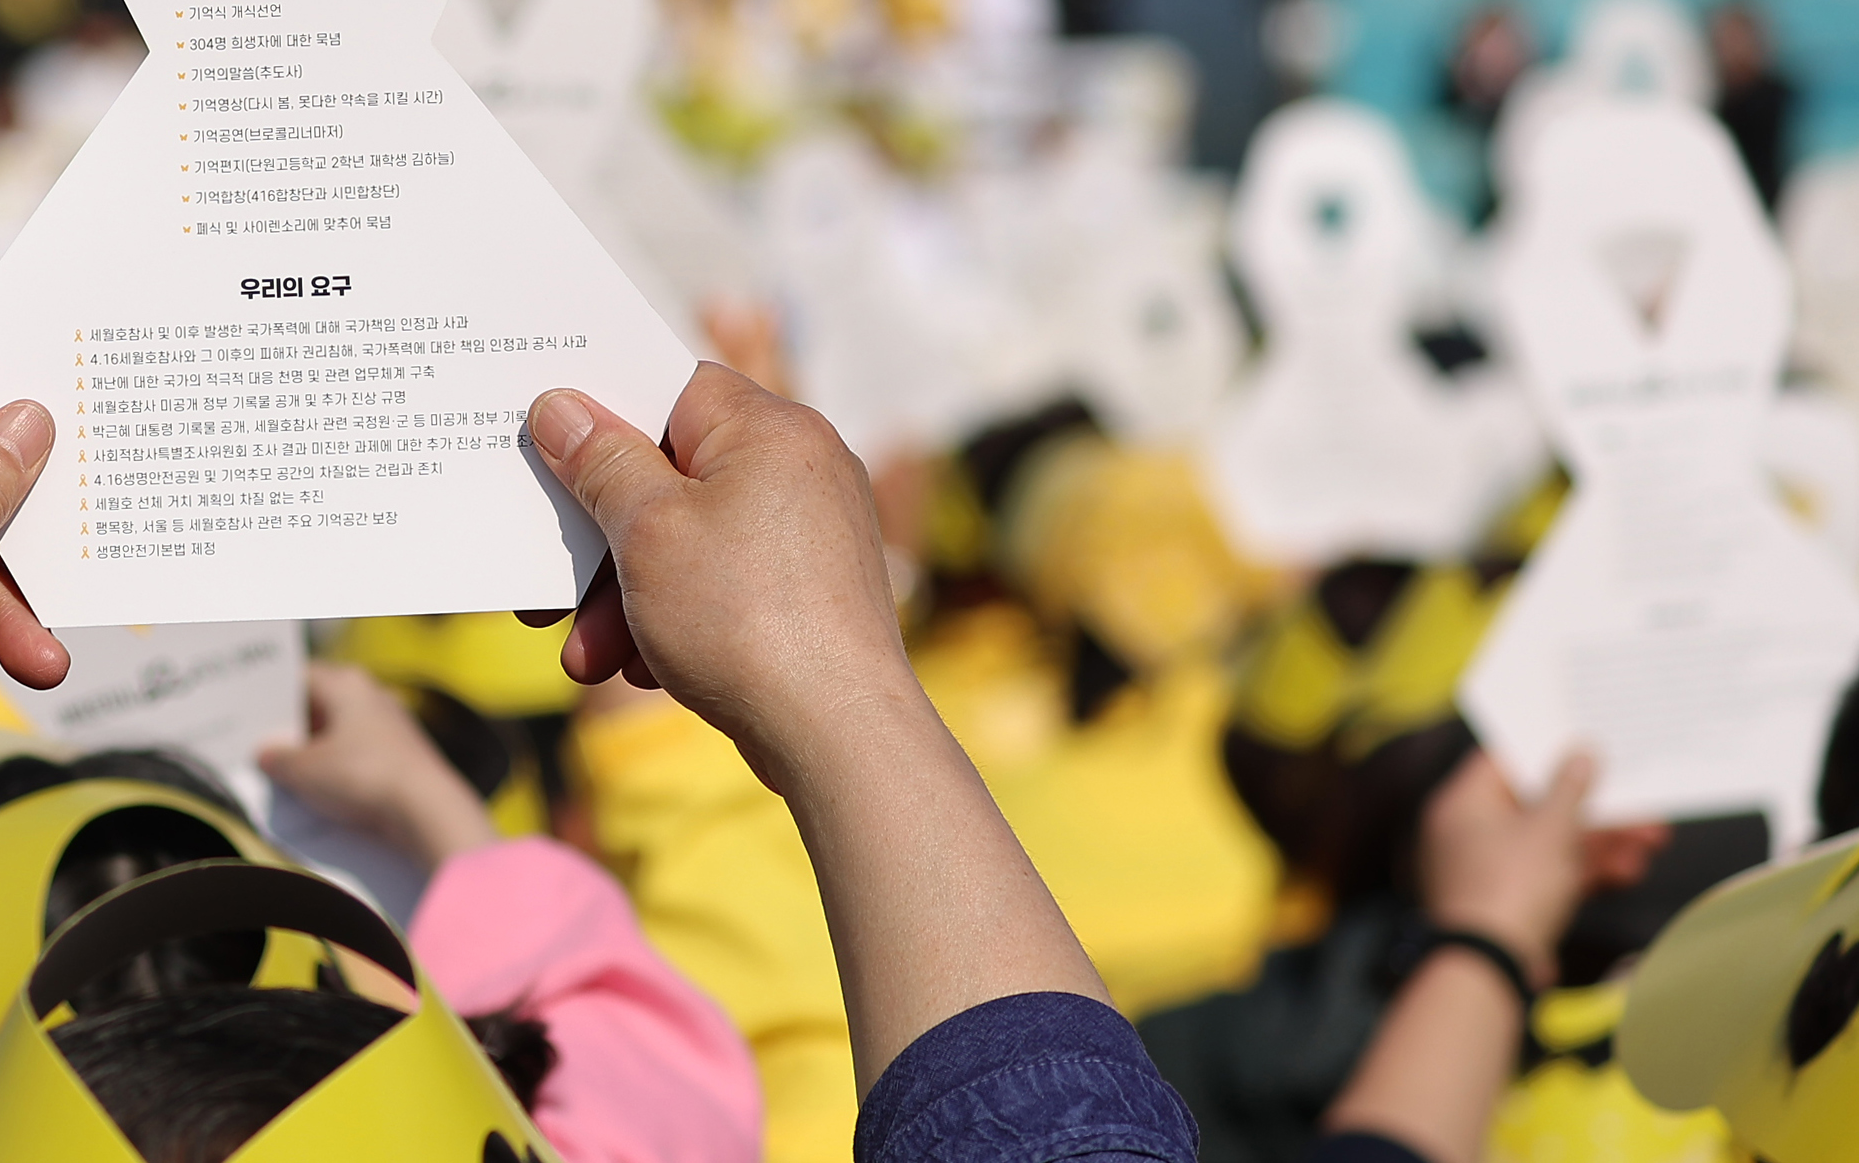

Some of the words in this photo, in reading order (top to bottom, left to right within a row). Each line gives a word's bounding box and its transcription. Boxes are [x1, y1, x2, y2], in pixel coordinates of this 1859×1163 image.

[188, 5, 227, 21] 기억식
[231, 3, 282, 19] 개식선언
[189, 36, 227, 51] 304명
[231, 34, 282, 50] 희생자에
[286, 33, 313, 48] 대한
[316, 32, 341, 47] 묵념
[191, 63, 303, 82] 기억의말씀(추도사)
[192, 96, 273, 113] 기억영상(다시
[277, 96, 294, 110] 봄,
[298, 94, 337, 109] 못다한
[340, 92, 379, 107] 약속을
[383, 91, 409, 106] 지킬
[413, 89, 443, 105] 시간)
[193, 123, 344, 144] 기억공연(브로콜리너마저)
[194, 156, 327, 174] 기억편지(단원고등학교
[331, 154, 365, 169] 2학년
[369, 153, 408, 168] 재학생
[411, 150, 455, 167] 김하늘)
[195, 186, 328, 205] 기억합창(416합창단과
[331, 183, 400, 200] 시민합창단)
[196, 221, 221, 236] 폐식
[225, 221, 238, 235] 및
[242, 218, 319, 234] 사이렌소리에
[323, 216, 362, 232] 맞추어
[366, 215, 391, 230] 묵념
[240, 276, 304, 300] 우리의
[310, 274, 353, 297] 요구
[89, 326, 154, 343] 세월호참사
[157, 326, 170, 341] 및
[174, 325, 200, 340] 이후
[204, 323, 243, 339] 발생한
[246, 321, 311, 337] 국가폭력에
[315, 320, 341, 334] 대해
[344, 318, 396, 334] 국가책임
[400, 316, 440, 332] 인정과
[442, 315, 469, 330] 사과
[89, 349, 197, 366] 4.16세월호참사와
[200, 348, 213, 363] 그
[217, 347, 255, 362] 이후의
[259, 345, 299, 360] 피해자
[302, 343, 358, 360] 권리침해,
[361, 341, 426, 357] 국가폭력에
[430, 340, 456, 355] 대한
[460, 338, 485, 354] 책임
[489, 337, 529, 353] 인정과
[532, 336, 558, 351] 공식
[561, 334, 588, 349] 사과
[91, 375, 129, 391] 재난에
[133, 374, 160, 389] 대한
[163, 373, 201, 388] 국가의
[206, 371, 244, 387] 적극적
[248, 370, 274, 385] 대응
[278, 369, 303, 385] 천명
[307, 369, 320, 384] 및
[324, 368, 350, 383] 관련
[354, 366, 405, 382] 업무체계
[409, 364, 435, 380] 구축
[91, 399, 157, 415] 세월호참사
[160, 397, 198, 413] 미공개
[203, 396, 228, 412] 정부
[232, 395, 271, 410] 기록물
[274, 394, 300, 409] 공개
[304, 393, 317, 408] 및
[321, 392, 348, 407] 추가
[351, 391, 378, 406] 진상
[381, 390, 406, 405] 규명
[92, 424, 131, 439] 박근혜
[135, 422, 173, 438] 대통령
[178, 421, 216, 436] 기록물
[220, 420, 250, 435] 공개,
[254, 417, 319, 433] 세월호참사
[322, 416, 348, 432] 관련
[413, 413, 426, 428] 등
[430, 412, 468, 427] 미공개
[472, 411, 498, 426] 정부
[93, 444, 247, 463] 사회적참사특별조사위원회
[252, 443, 278, 457] 조사
[281, 442, 308, 457] 결과
[311, 440, 350, 456] 미진한
[354, 439, 392, 454] 과제에
[396, 437, 423, 452] 대한
[426, 436, 453, 452] 추가
[456, 435, 482, 451] 진상
[486, 434, 512, 450] 규명
[93, 469, 200, 487] 4.16생명안전공원
[204, 469, 217, 484] 및
[221, 467, 273, 483] 기억추모
[276, 465, 315, 481] 공간의
[319, 464, 371, 479] 차질없는
[375, 462, 414, 478] 건립과
[417, 461, 443, 476] 존치
[94, 496, 133, 511] 세월호
[137, 495, 163, 510] 선체
[167, 494, 192, 509] 거치
[197, 492, 235, 508] 계획의
[239, 491, 265, 506] 차질
[269, 491, 295, 506] 없는
[299, 489, 324, 504] 추진
[95, 520, 138, 536] 팽목항,
[142, 519, 168, 534] 서울
[172, 518, 185, 533] 등
[188, 516, 254, 532] 세월호참사
[257, 515, 282, 530] 관련
[287, 514, 313, 529] 주요
[317, 512, 369, 527] 기억공간
[372, 511, 399, 526] 보장
[96, 542, 186, 560] 생명안전기본법
[190, 541, 216, 556] 제정
